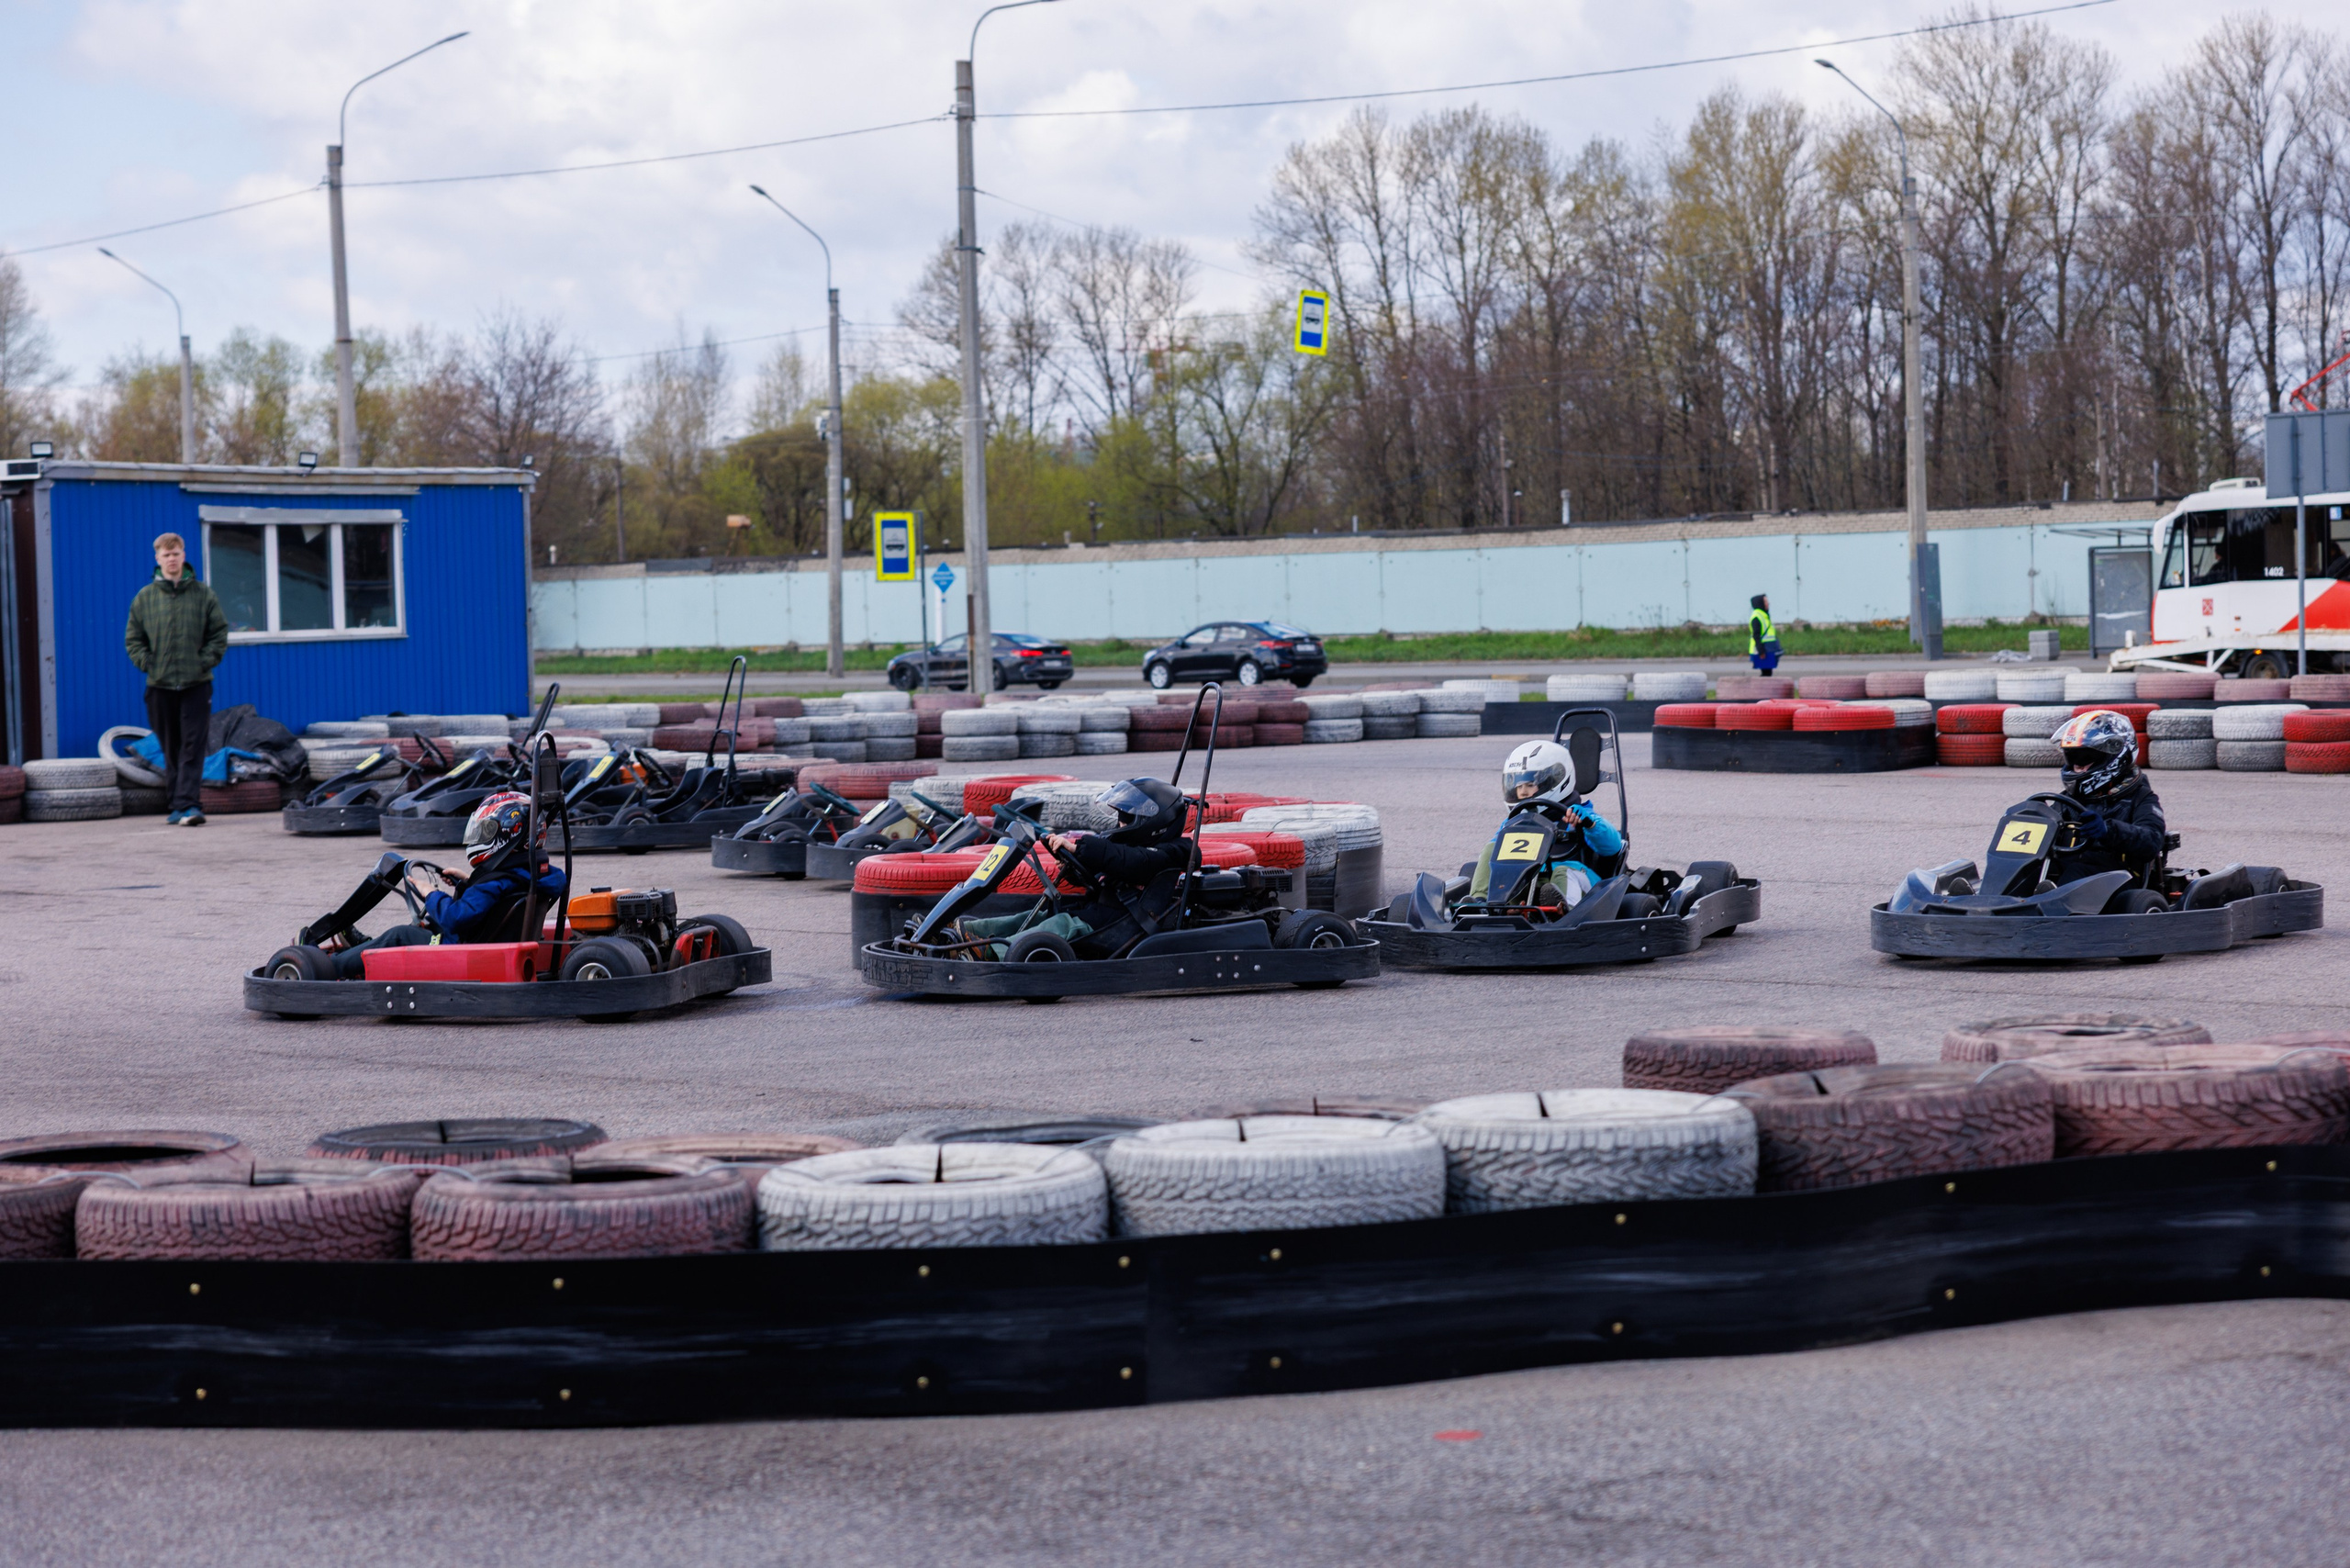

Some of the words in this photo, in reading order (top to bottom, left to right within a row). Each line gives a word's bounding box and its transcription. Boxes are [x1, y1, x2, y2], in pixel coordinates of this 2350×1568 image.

[2011, 830, 2031, 846] 4
[1510, 839, 1530, 854] 2
[980, 853, 1000, 872] 12
